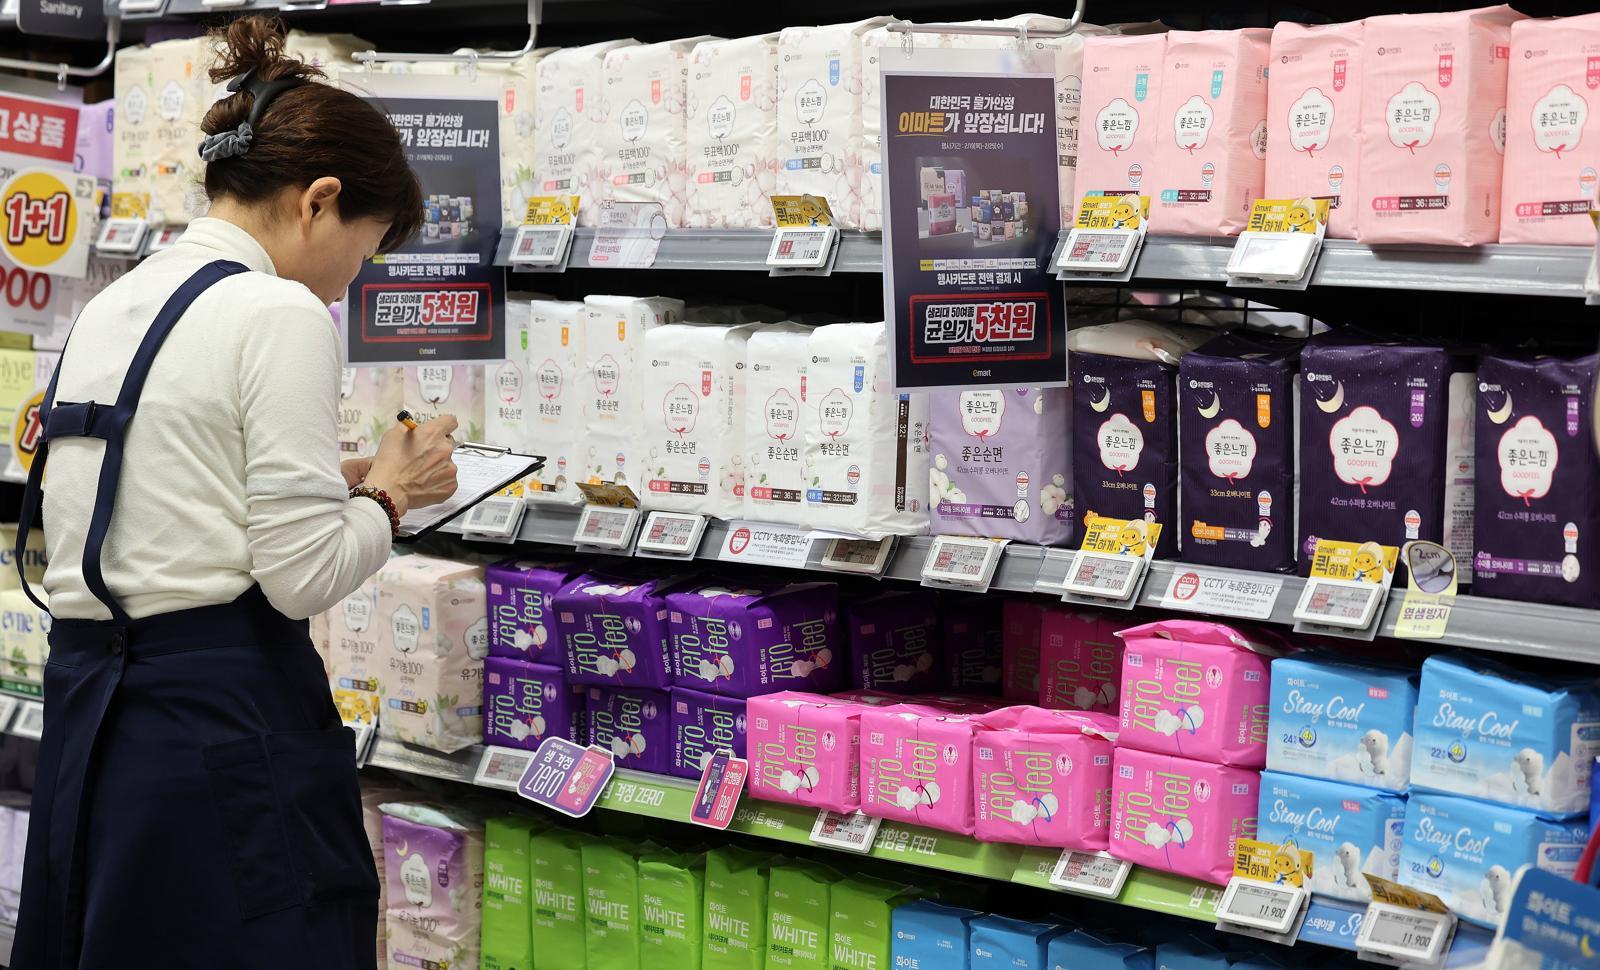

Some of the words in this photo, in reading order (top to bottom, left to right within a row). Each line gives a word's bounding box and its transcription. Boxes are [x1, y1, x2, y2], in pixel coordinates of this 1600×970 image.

[40, 0, 83, 18] Sanitary
[929, 95, 971, 110] 대한민국
[973, 93, 1015, 111] 물가안정
[386, 113, 424, 128] 한민국
[425, 112, 464, 128] 물가안정
[898, 111, 961, 134] 이마트가
[963, 113, 1045, 135] 앞장섭니다!
[1102, 119, 1132, 132] 좋은느낌
[1180, 117, 1207, 130] 좋은느낌
[1295, 112, 1327, 128] 좋은느낌
[1394, 108, 1432, 124] 좋은느낌
[1539, 111, 1578, 128] 좋은느낌
[416, 129, 490, 148] 앞장섭니다!
[5, 192, 70, 246] 1+1
[388, 265, 425, 277] 행사카드로
[426, 266, 441, 277] 전액
[442, 266, 457, 277] 결제
[458, 265, 466, 277] 시
[937, 272, 976, 285] 행사카드로
[978, 272, 994, 285] 전액
[996, 272, 1012, 285] 결제
[1013, 272, 1022, 285] 시
[376, 305, 421, 325] 균일가
[421, 291, 479, 324] 5천원
[378, 294, 399, 305] 생리대
[926, 319, 975, 342] 균일가
[975, 303, 1036, 341] 5천원
[927, 306, 950, 319] 생리대
[951, 306, 975, 318] 50여종
[966, 401, 998, 414] 좋은느낌
[665, 440, 696, 455] 좋은순면
[768, 446, 798, 461] 좋은순면
[820, 443, 849, 457] 좋은순면
[962, 446, 1003, 463] 좋은순면
[1105, 435, 1137, 450] 좋은느낌
[1213, 442, 1249, 456] 좋은느낌
[1340, 437, 1387, 456] 좋은느낌
[1346, 459, 1378, 468] GOODFEEL
[1508, 449, 1548, 467] 좋은느낌
[1210, 489, 1225, 497] 33cm
[1330, 497, 1348, 506] 42cm
[1366, 499, 1396, 509] 오버나이트
[753, 531, 772, 541] CCTV
[1415, 547, 1441, 560] 2cm
[1181, 576, 1197, 585] CCTV
[1203, 577, 1228, 589] CCTV
[1228, 580, 1275, 597] 녹화중입니다
[516, 588, 543, 625] feel
[498, 605, 518, 648] zero
[592, 613, 629, 650] feel
[697, 616, 729, 655] feel
[792, 619, 827, 654] feel
[573, 632, 600, 677] zero
[680, 634, 704, 679] zero
[757, 643, 796, 683] zero
[1163, 658, 1204, 705] feel
[516, 678, 543, 715] feel
[1132, 680, 1164, 733] zero
[1283, 689, 1324, 724] Stay
[1326, 696, 1365, 723] Cool
[494, 694, 516, 737] zero
[1432, 703, 1476, 738] Stay
[1478, 711, 1519, 741] Cool
[704, 707, 734, 750] feel
[1283, 733, 1293, 744] 24
[683, 725, 706, 772] zero
[786, 724, 818, 766] feel
[543, 750, 557, 764] 샘
[556, 753, 575, 771] 걱정
[763, 743, 787, 792] zero
[903, 739, 939, 783] feel
[1015, 751, 1053, 793] feel
[525, 763, 566, 799] zero
[877, 758, 903, 808] zero
[615, 783, 637, 804] 걱정
[636, 787, 665, 807] ZERO
[990, 772, 1017, 823] zero
[1152, 772, 1192, 819] feel
[1123, 791, 1153, 845] zero
[1269, 799, 1304, 833] Stay
[1306, 807, 1341, 835] Cool
[909, 835, 937, 855] FEEL
[1414, 816, 1452, 853] Stay
[1455, 827, 1490, 857] Cool
[487, 871, 523, 894] WHITE
[535, 889, 577, 912] WHITE
[587, 896, 629, 921] WHITE
[1189, 886, 1207, 908] 샘
[643, 904, 686, 929] WHITE
[708, 911, 749, 939] WHITE
[772, 923, 818, 949] WHITE
[833, 944, 877, 970] WHITE
